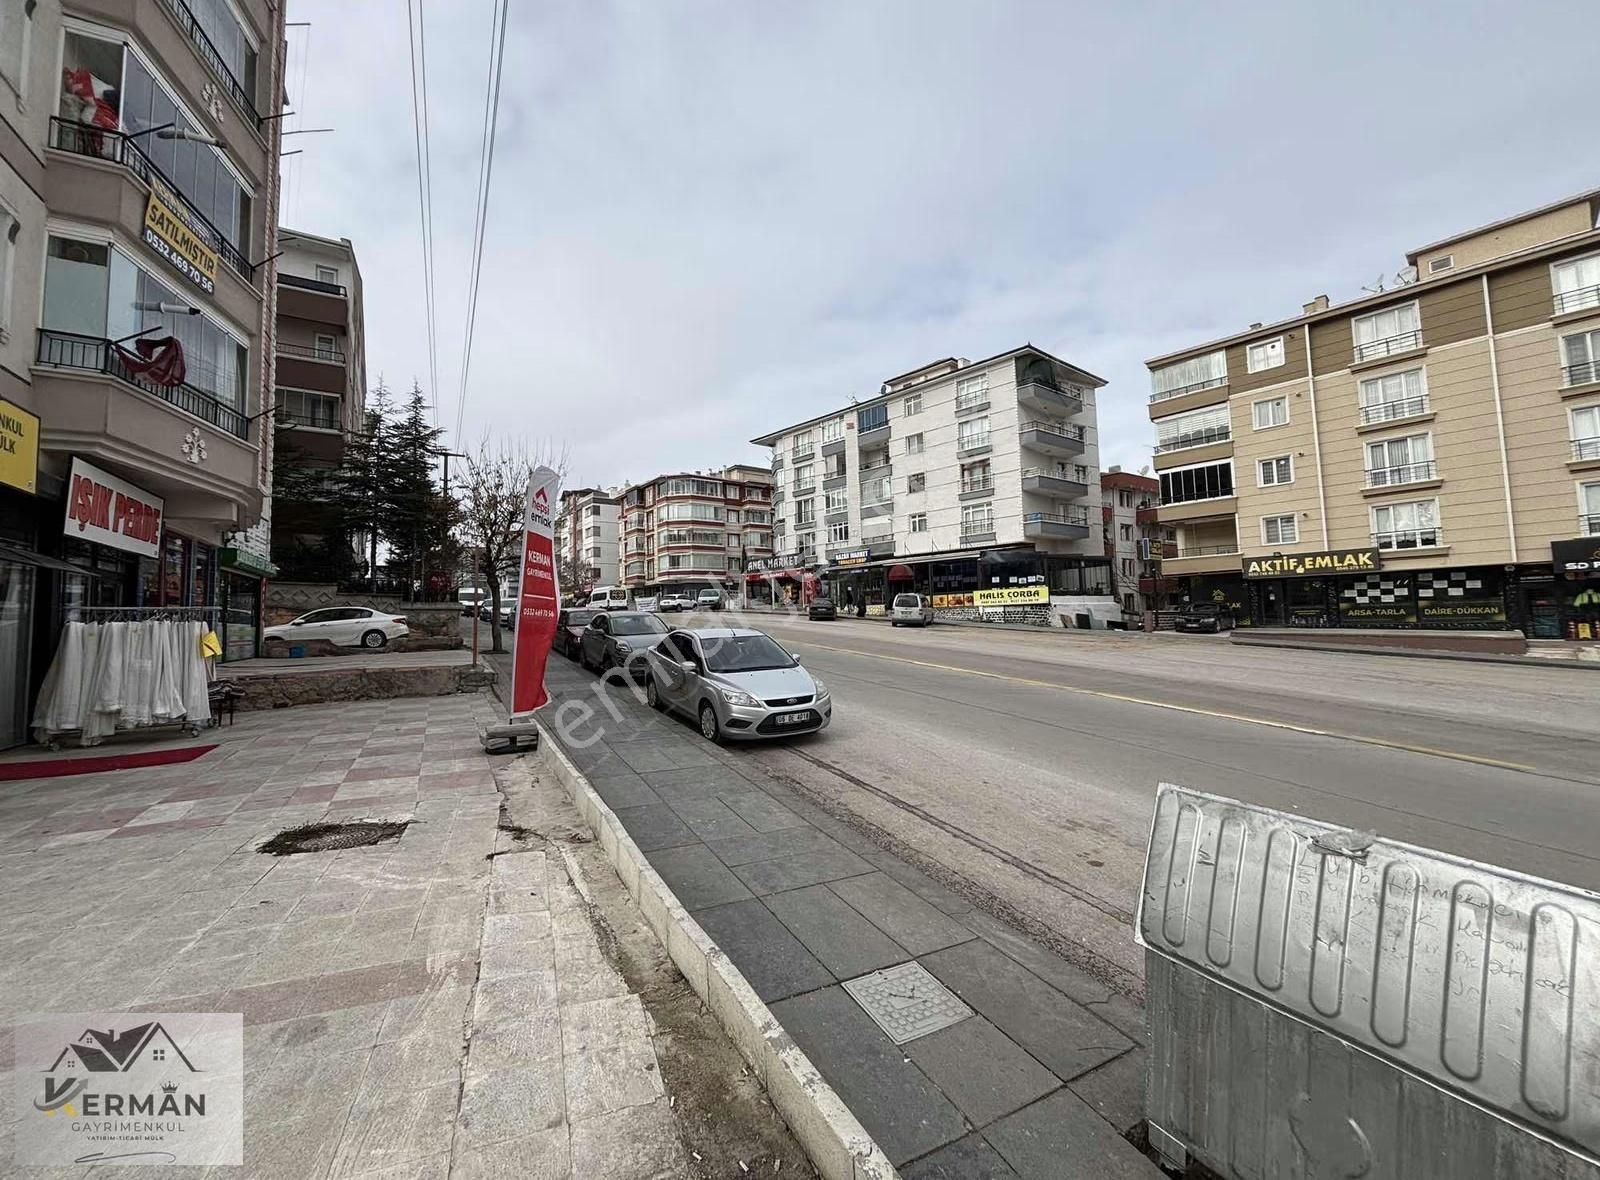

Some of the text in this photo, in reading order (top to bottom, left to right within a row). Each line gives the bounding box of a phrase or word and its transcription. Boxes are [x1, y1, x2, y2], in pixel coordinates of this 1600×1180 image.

[149, 204, 215, 276] SATILMIŞTIR
[146, 229, 213, 293] 0532 469 70 56
[69, 474, 112, 532] IŞIK
[767, 555, 799, 569] MARKET
[1248, 556, 1298, 574] AKTİF
[1304, 552, 1373, 569] EMLAK
[1347, 608, 1406, 617] ARSA-TARLA
